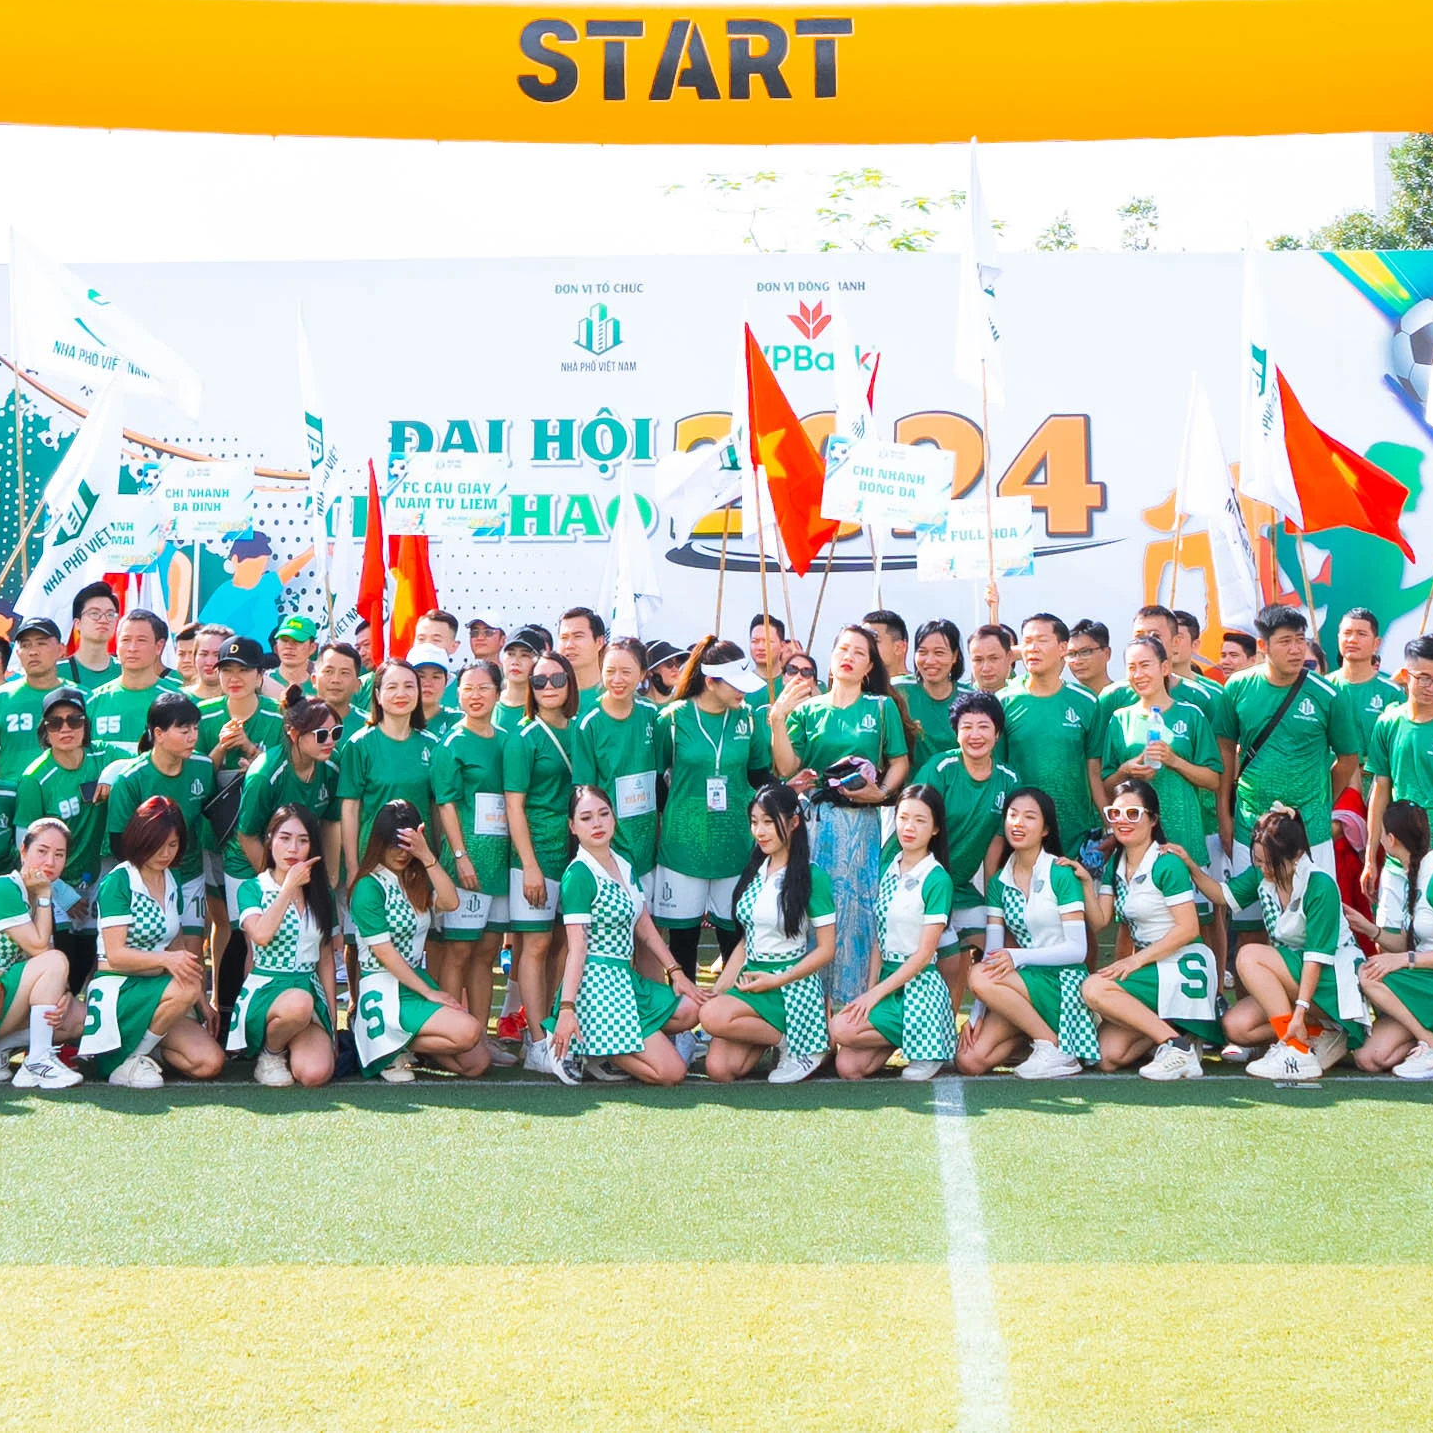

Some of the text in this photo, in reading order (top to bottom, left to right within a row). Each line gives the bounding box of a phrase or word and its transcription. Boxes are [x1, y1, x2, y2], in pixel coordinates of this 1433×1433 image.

[517, 18, 854, 102] START
[618, 361, 637, 372] NAM
[530, 406, 653, 474] HỘI
[853, 465, 874, 478] CHI
[165, 488, 184, 499] CHI
[402, 481, 419, 494] FC
[395, 496, 431, 509] NAM
[929, 529, 946, 543] FC
[950, 527, 986, 542] FULL
[229, 644, 239, 654] D
[6, 712, 33, 733] 23
[1177, 952, 1208, 999] S
[359, 990, 385, 1040] S
